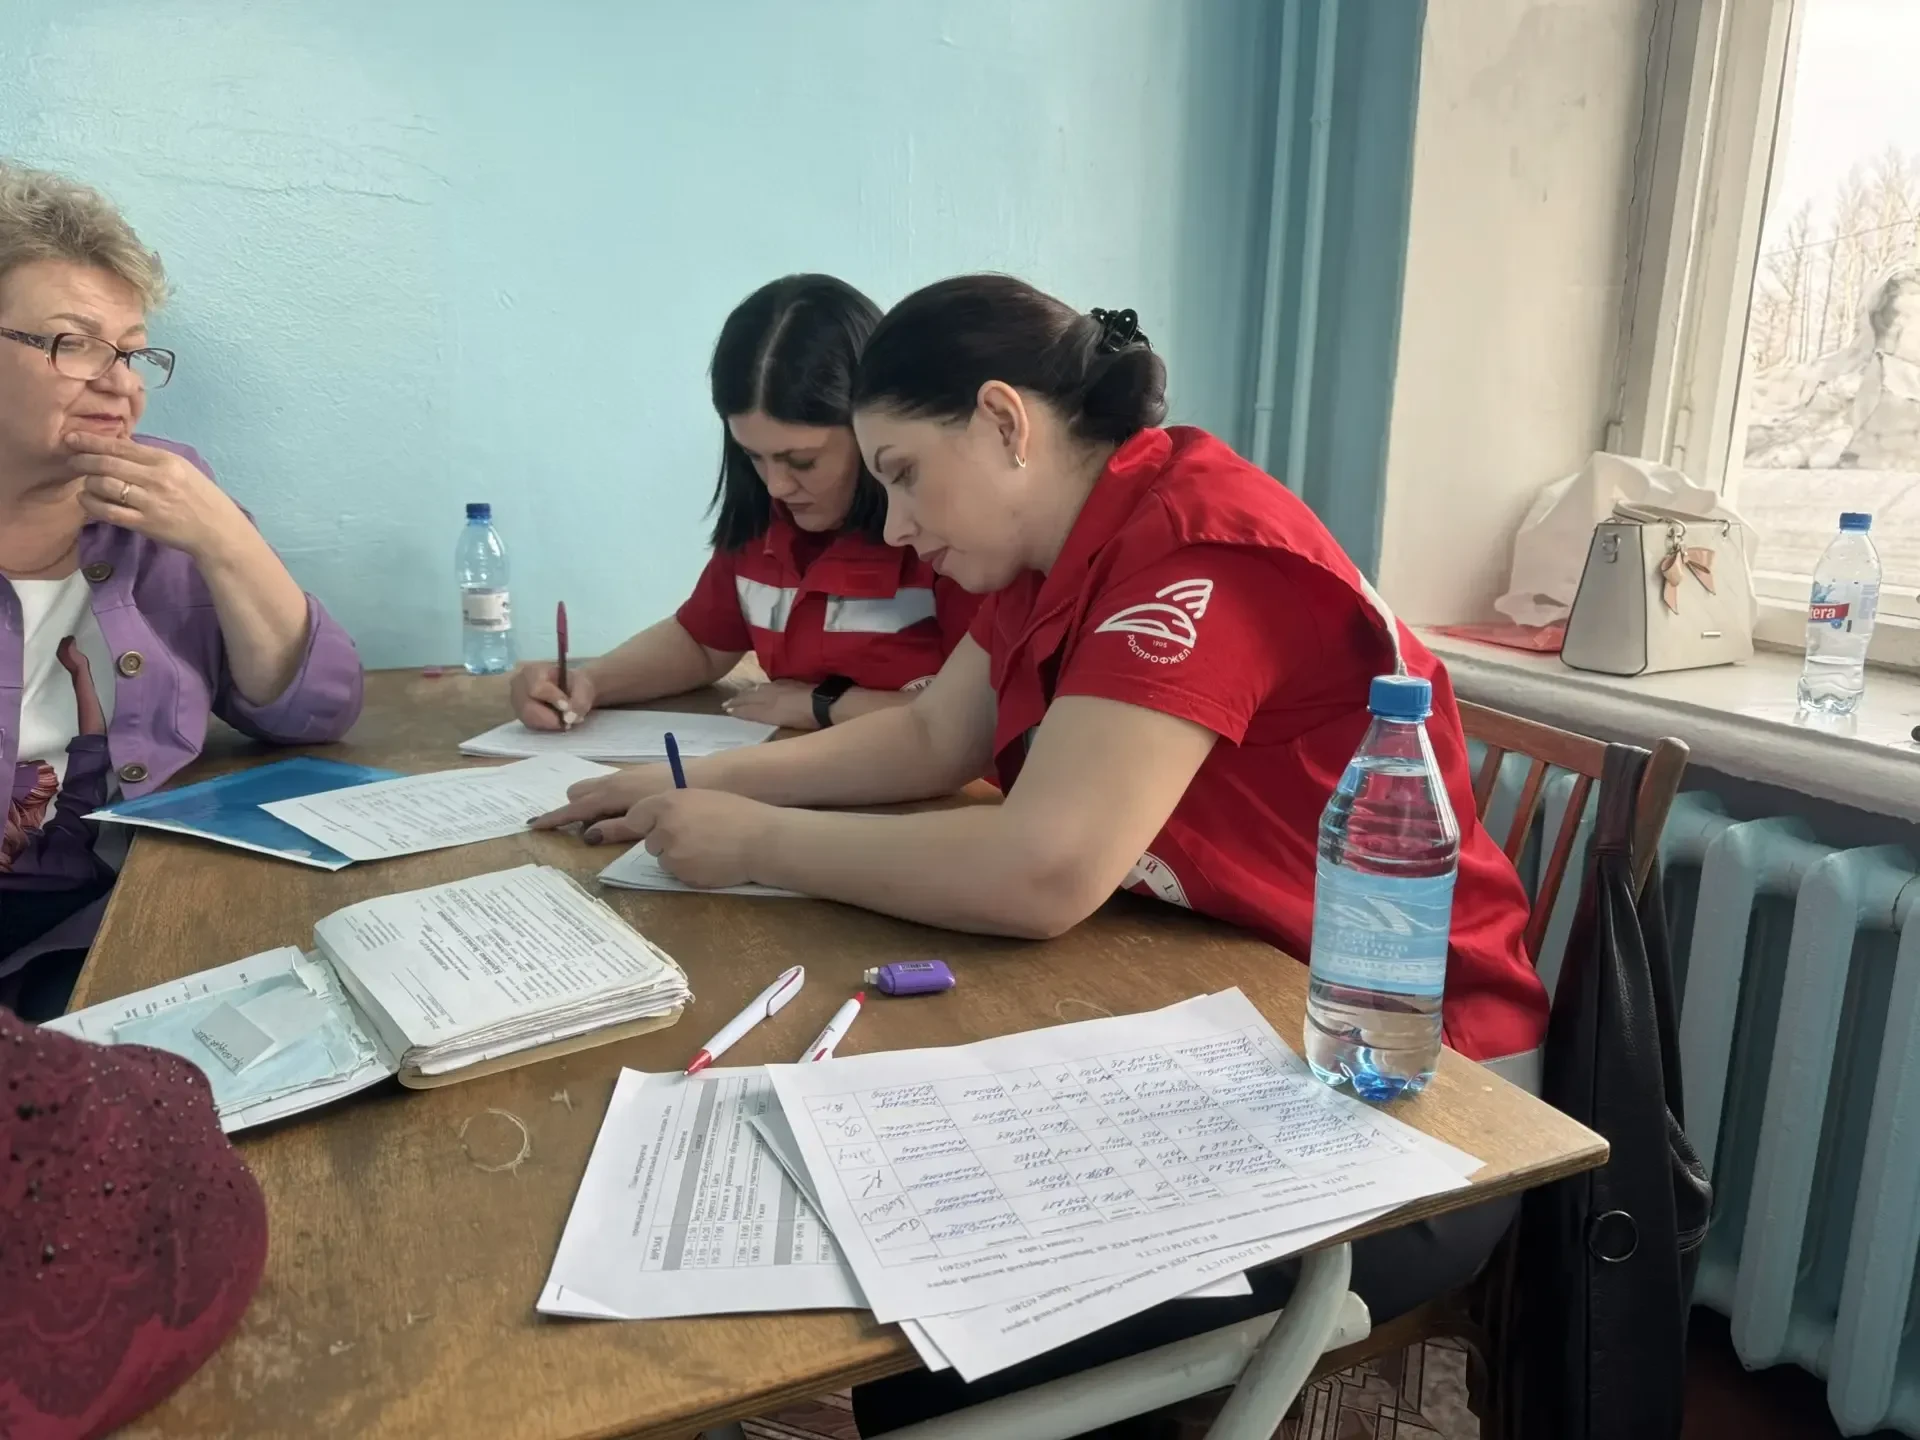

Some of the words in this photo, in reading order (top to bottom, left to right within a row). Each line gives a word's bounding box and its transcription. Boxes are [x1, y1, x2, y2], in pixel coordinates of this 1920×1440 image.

[1127, 634, 1191, 665] РОСПРОФЖЕЛ
[1152, 639, 1168, 649] 1905
[1132, 1232, 1221, 1259] ВЕДОМОСТЬ
[1194, 1242, 1273, 1274] ВЕДОМОСТЬ
